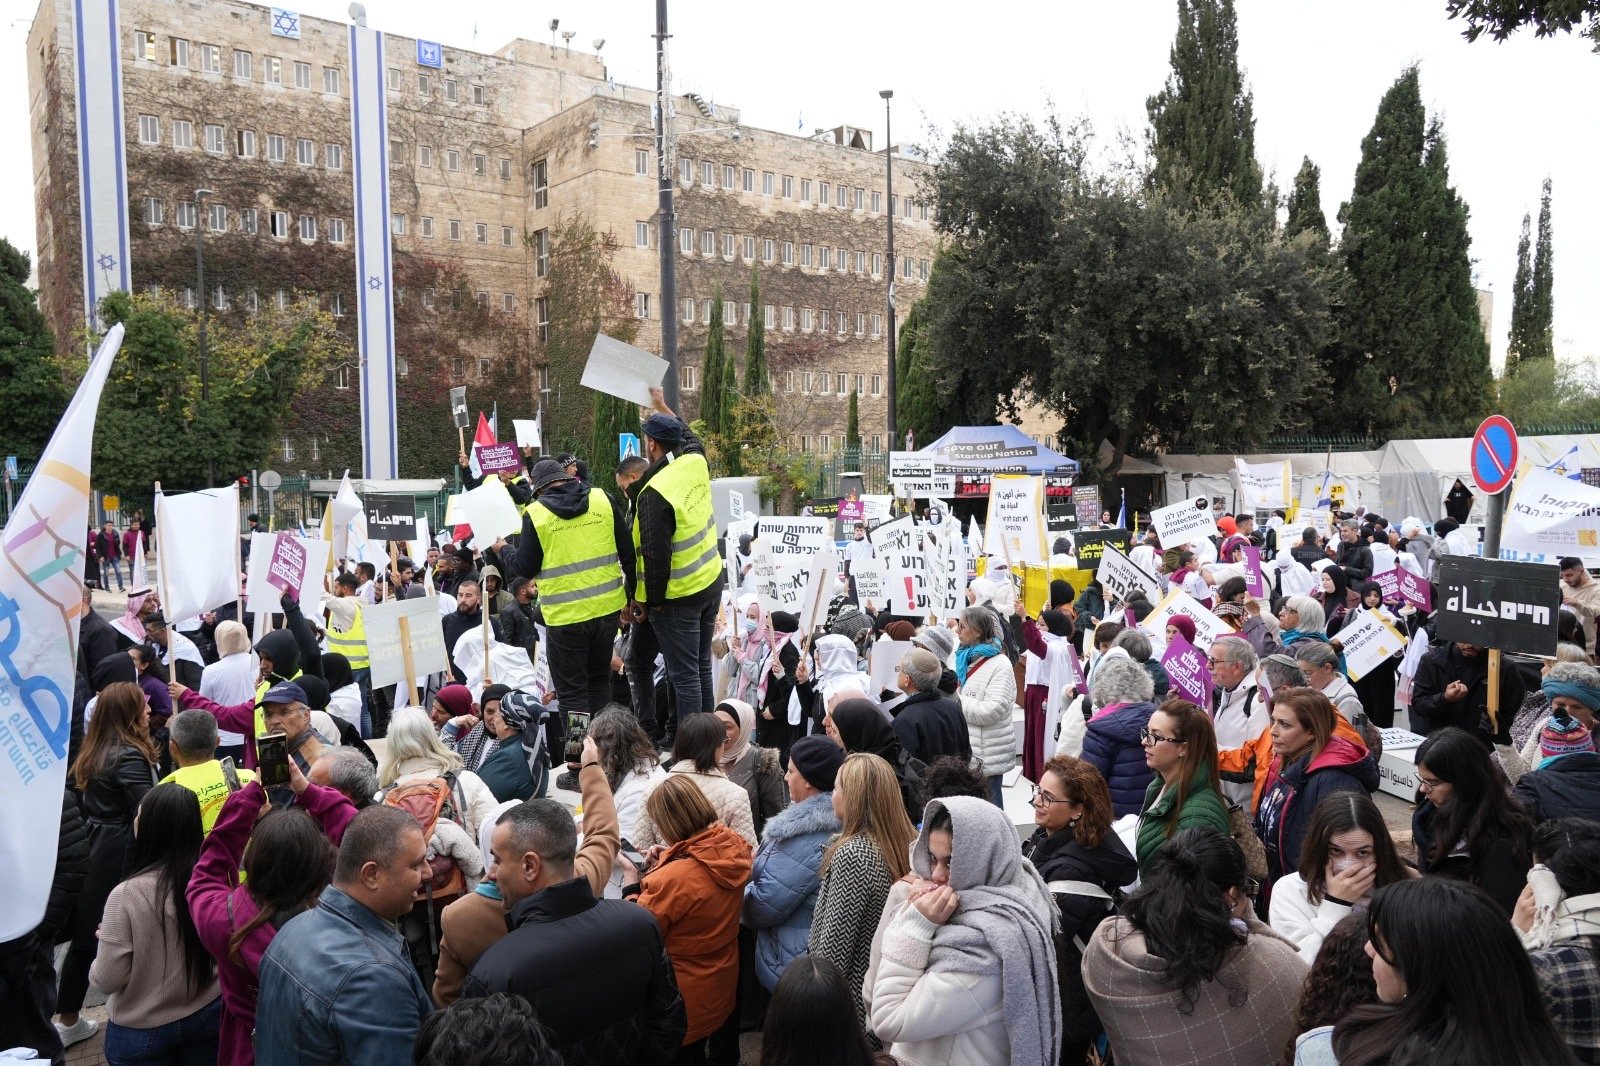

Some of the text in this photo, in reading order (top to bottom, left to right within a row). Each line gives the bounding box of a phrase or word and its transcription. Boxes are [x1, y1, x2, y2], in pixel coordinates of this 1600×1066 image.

[954, 449, 1033, 459] Startup Nation
[976, 442, 999, 451] our
[945, 465, 984, 474] Startup
[986, 465, 1022, 473] Nation
[1165, 512, 1175, 520] לנו
[1513, 502, 1540, 518] הבא
[369, 509, 414, 530] חיים حياة
[1047, 513, 1060, 525] حيا
[1164, 512, 1202, 528] Protection
[760, 524, 823, 534] אזרחות שווה
[1161, 522, 1199, 538] protection
[771, 545, 785, 554] שו
[792, 568, 810, 589] לא
[1106, 561, 1129, 582] אזרחים
[1120, 564, 1138, 581] אנחנו
[782, 591, 797, 603] נרצ
[1446, 584, 1550, 626] חיים حياة
[1200, 619, 1211, 632] חיי
[1364, 622, 1372, 631] יש
[1201, 634, 1213, 645] לא
[1170, 655, 1192, 678] الجريمة
[1183, 655, 1198, 671] ביחד
[1166, 662, 1199, 695] נגד הפשיעה
[1391, 770, 1413, 788] حاسبوا
[197, 782, 227, 797] صحراء
